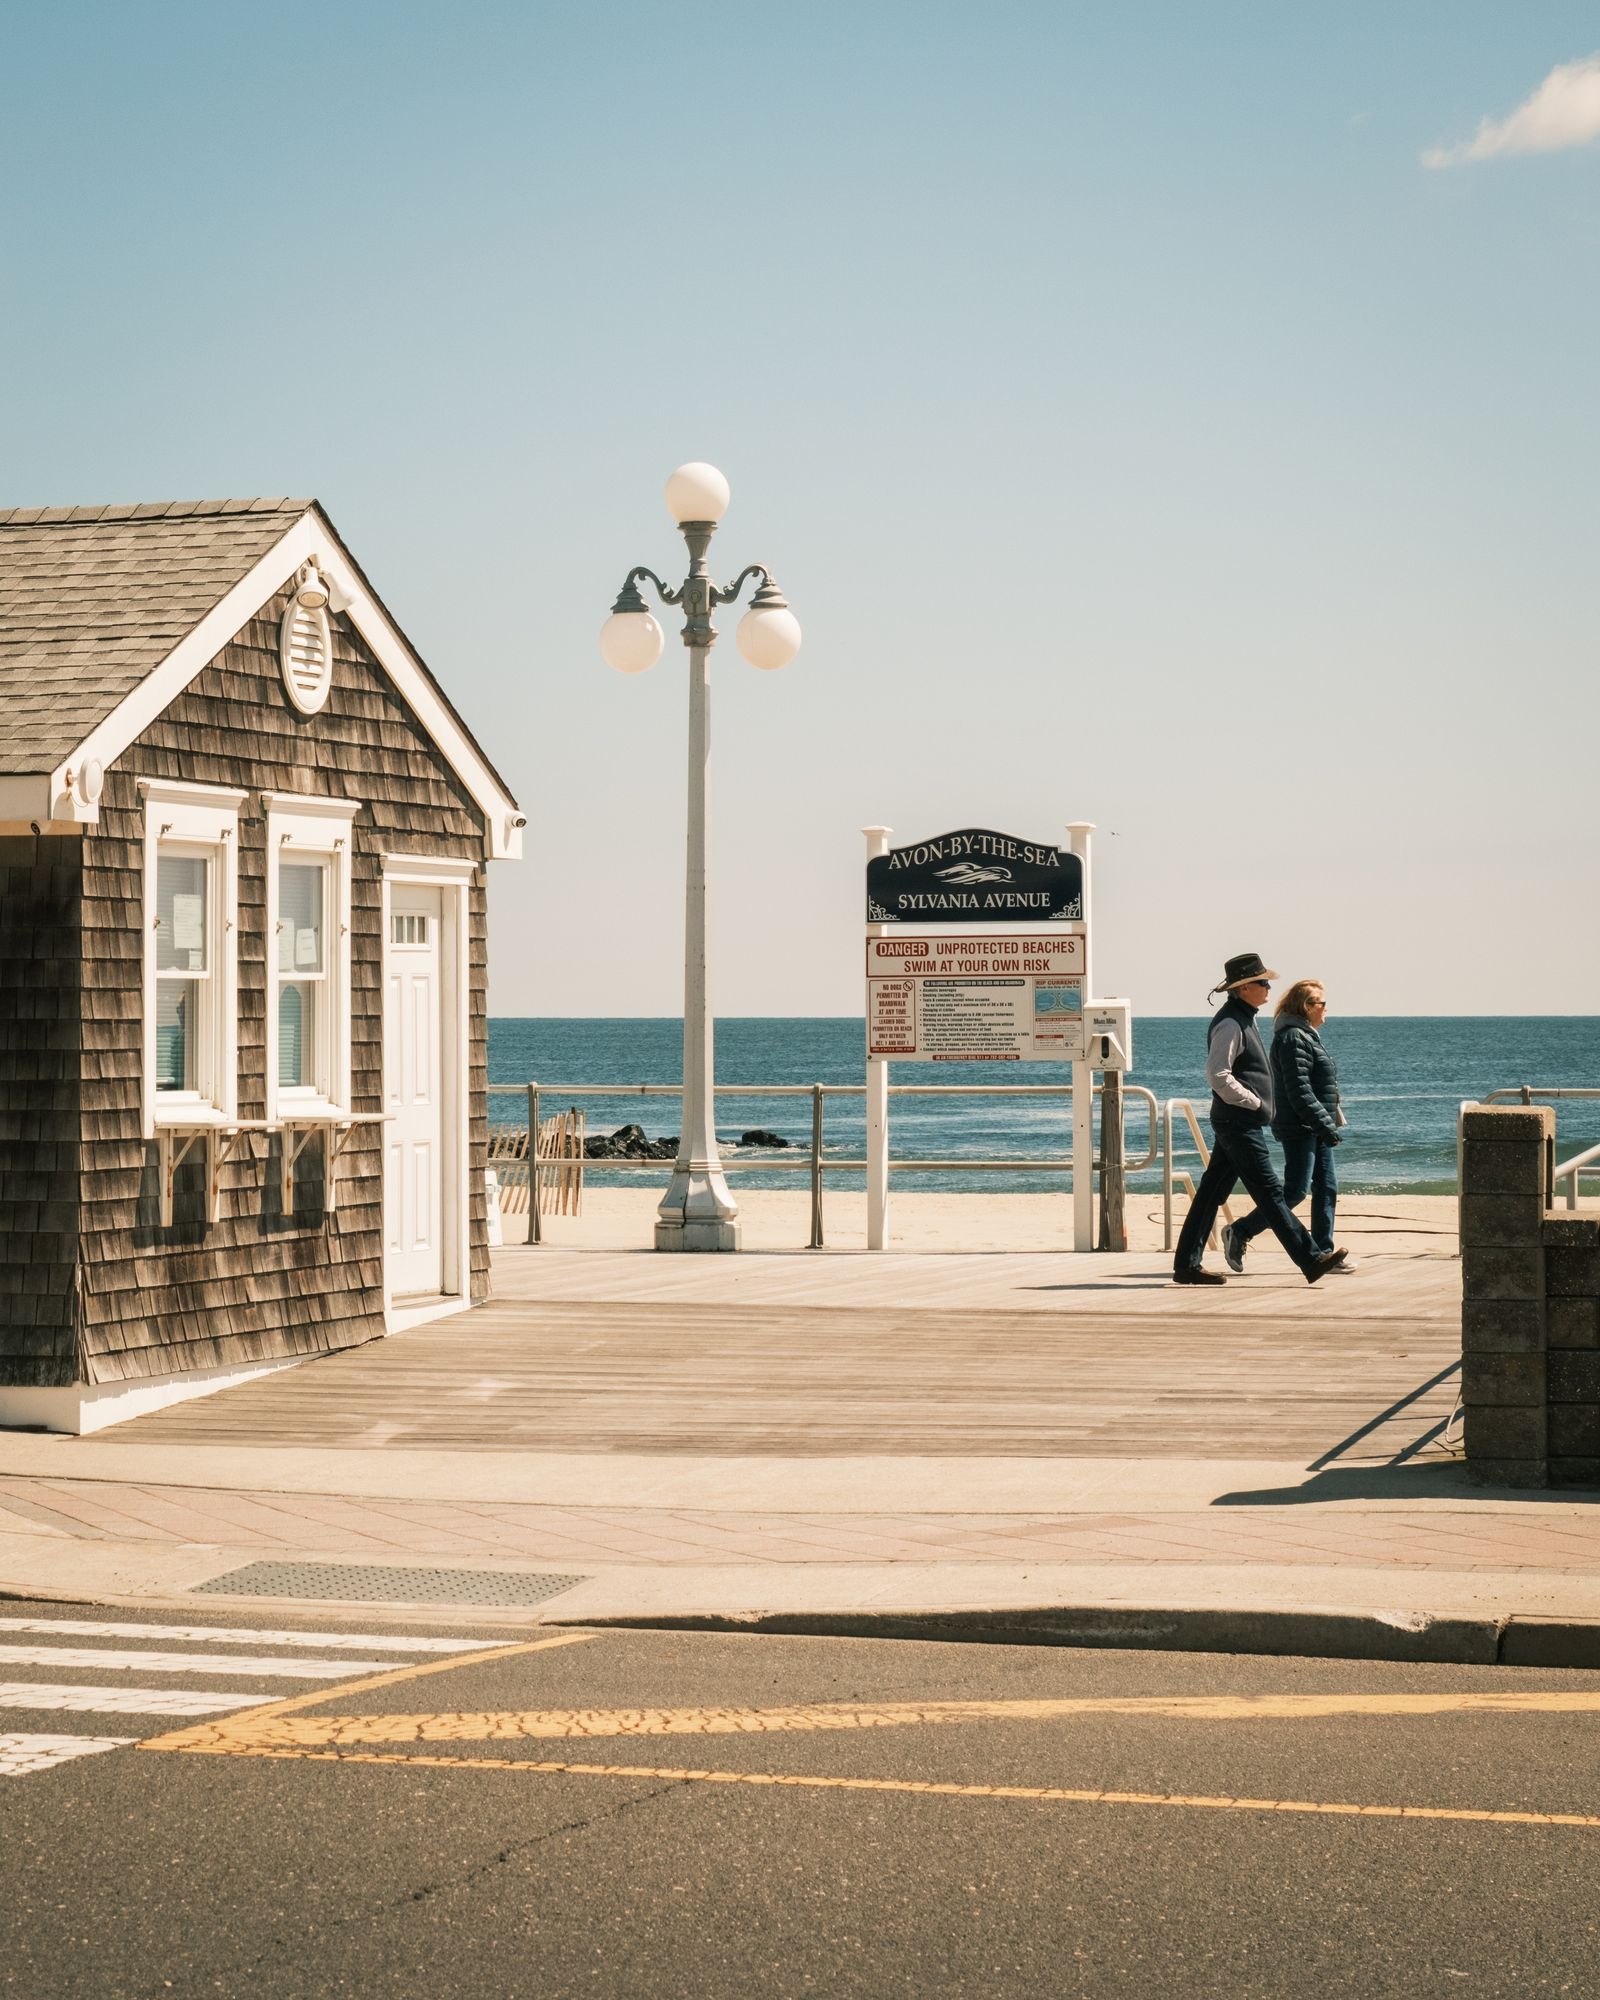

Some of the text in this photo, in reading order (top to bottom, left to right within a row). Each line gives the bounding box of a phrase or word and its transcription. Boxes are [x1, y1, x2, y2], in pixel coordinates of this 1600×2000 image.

[888, 834, 1061, 870] AVON-BY-THE-SEA
[898, 892, 1051, 909] SYLVANIA AVENUE
[878, 941, 1075, 956] DANGER UNPROTECTED BEACHES
[904, 959, 1050, 973] SWIM AT YOUR OWN RISK
